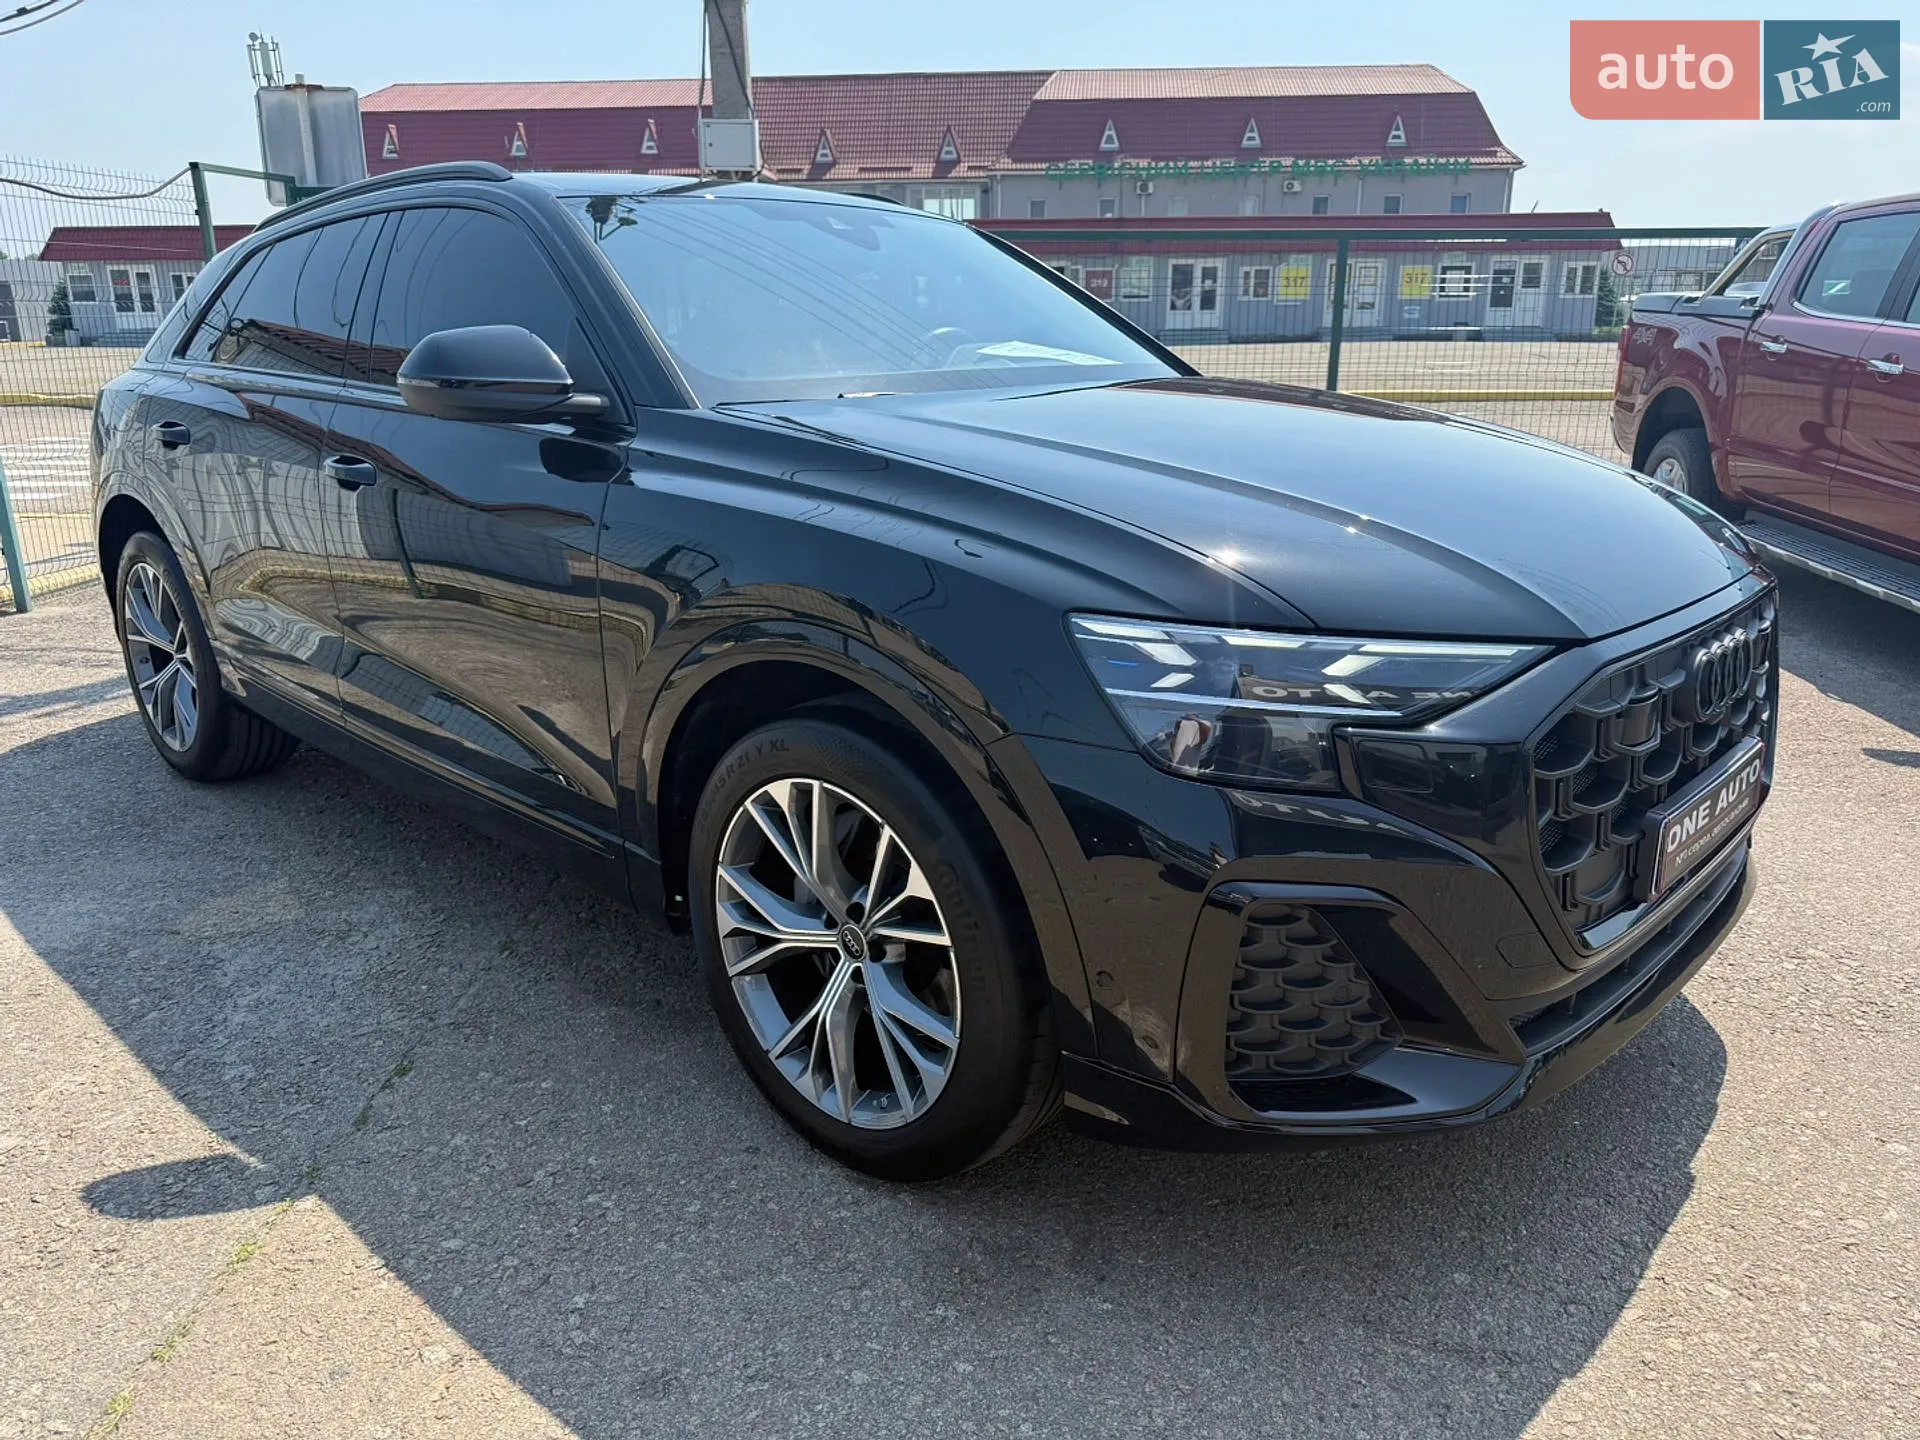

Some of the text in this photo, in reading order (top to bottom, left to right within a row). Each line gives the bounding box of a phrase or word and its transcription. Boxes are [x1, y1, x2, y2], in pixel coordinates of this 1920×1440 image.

[1283, 276, 1306, 288] 317
[1404, 272, 1427, 285] 317
[737, 751, 751, 770] 21
[769, 738, 790, 753] XL
[1667, 758, 1760, 853] ONE AUTO
